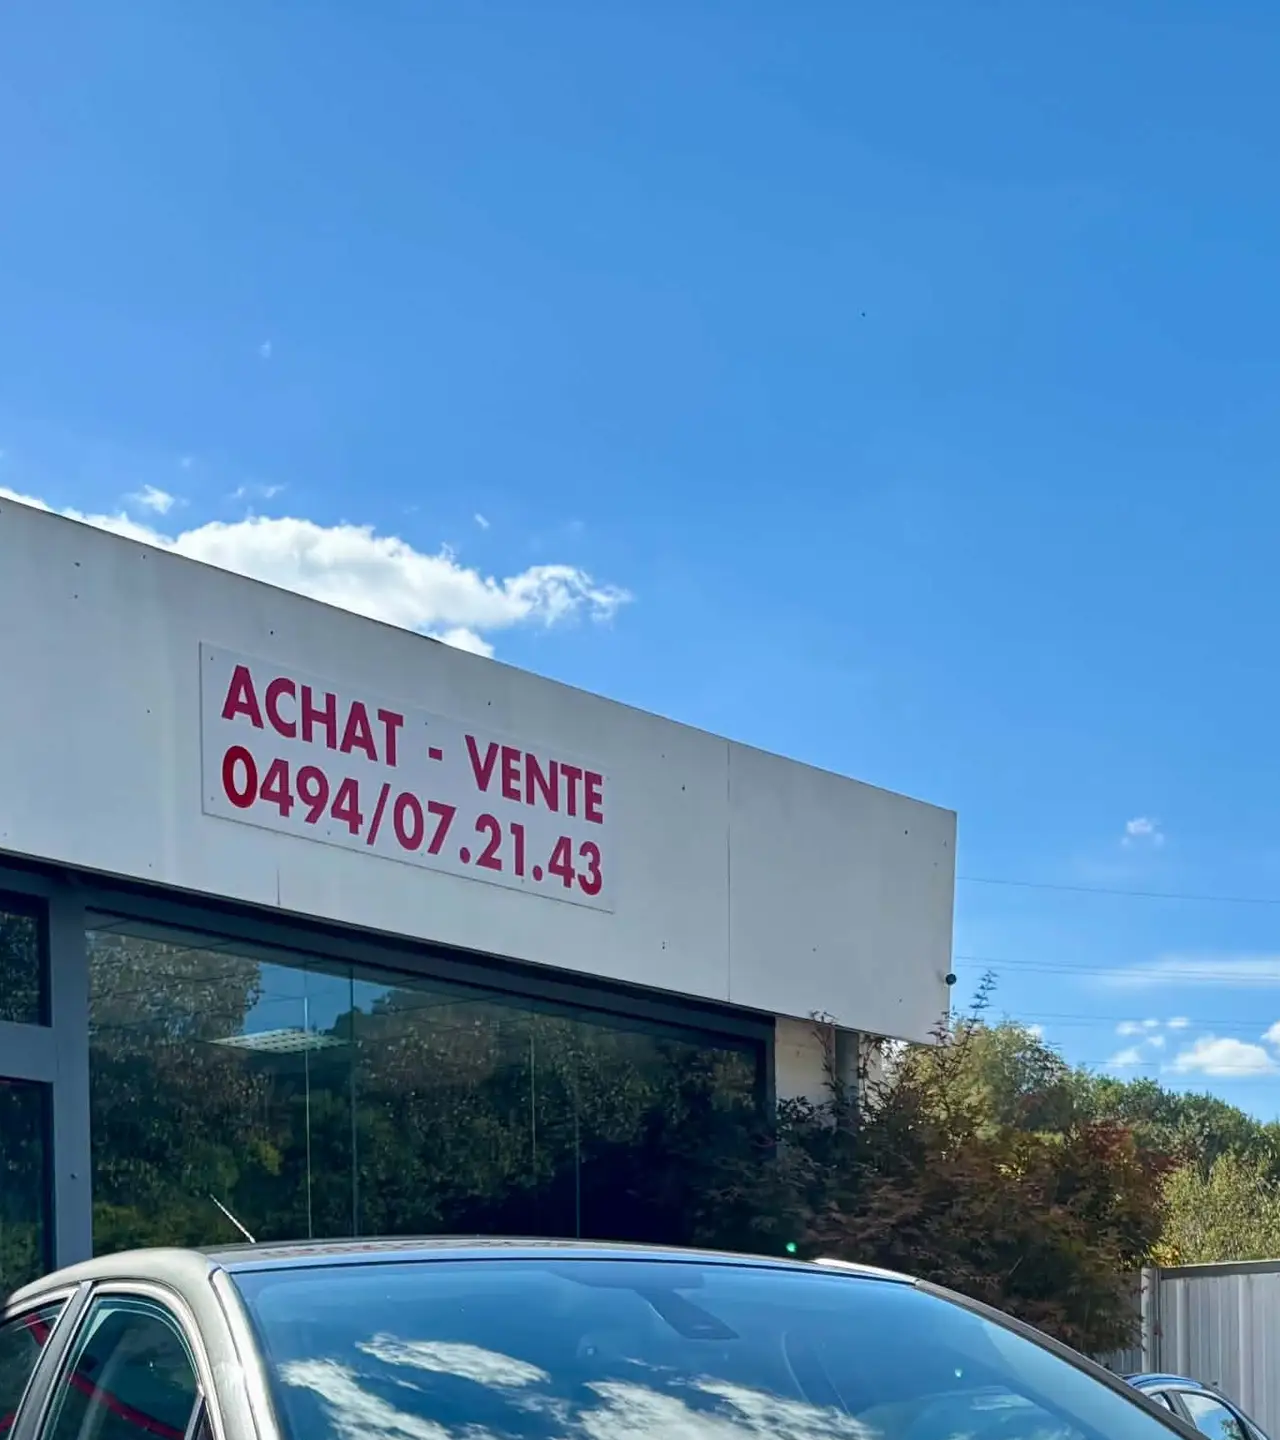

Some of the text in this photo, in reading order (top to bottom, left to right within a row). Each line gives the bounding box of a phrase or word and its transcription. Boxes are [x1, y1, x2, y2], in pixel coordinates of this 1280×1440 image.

[221, 664, 605, 825] ACHAT - VENTE
[222, 744, 603, 896] 0494/07.21.43
